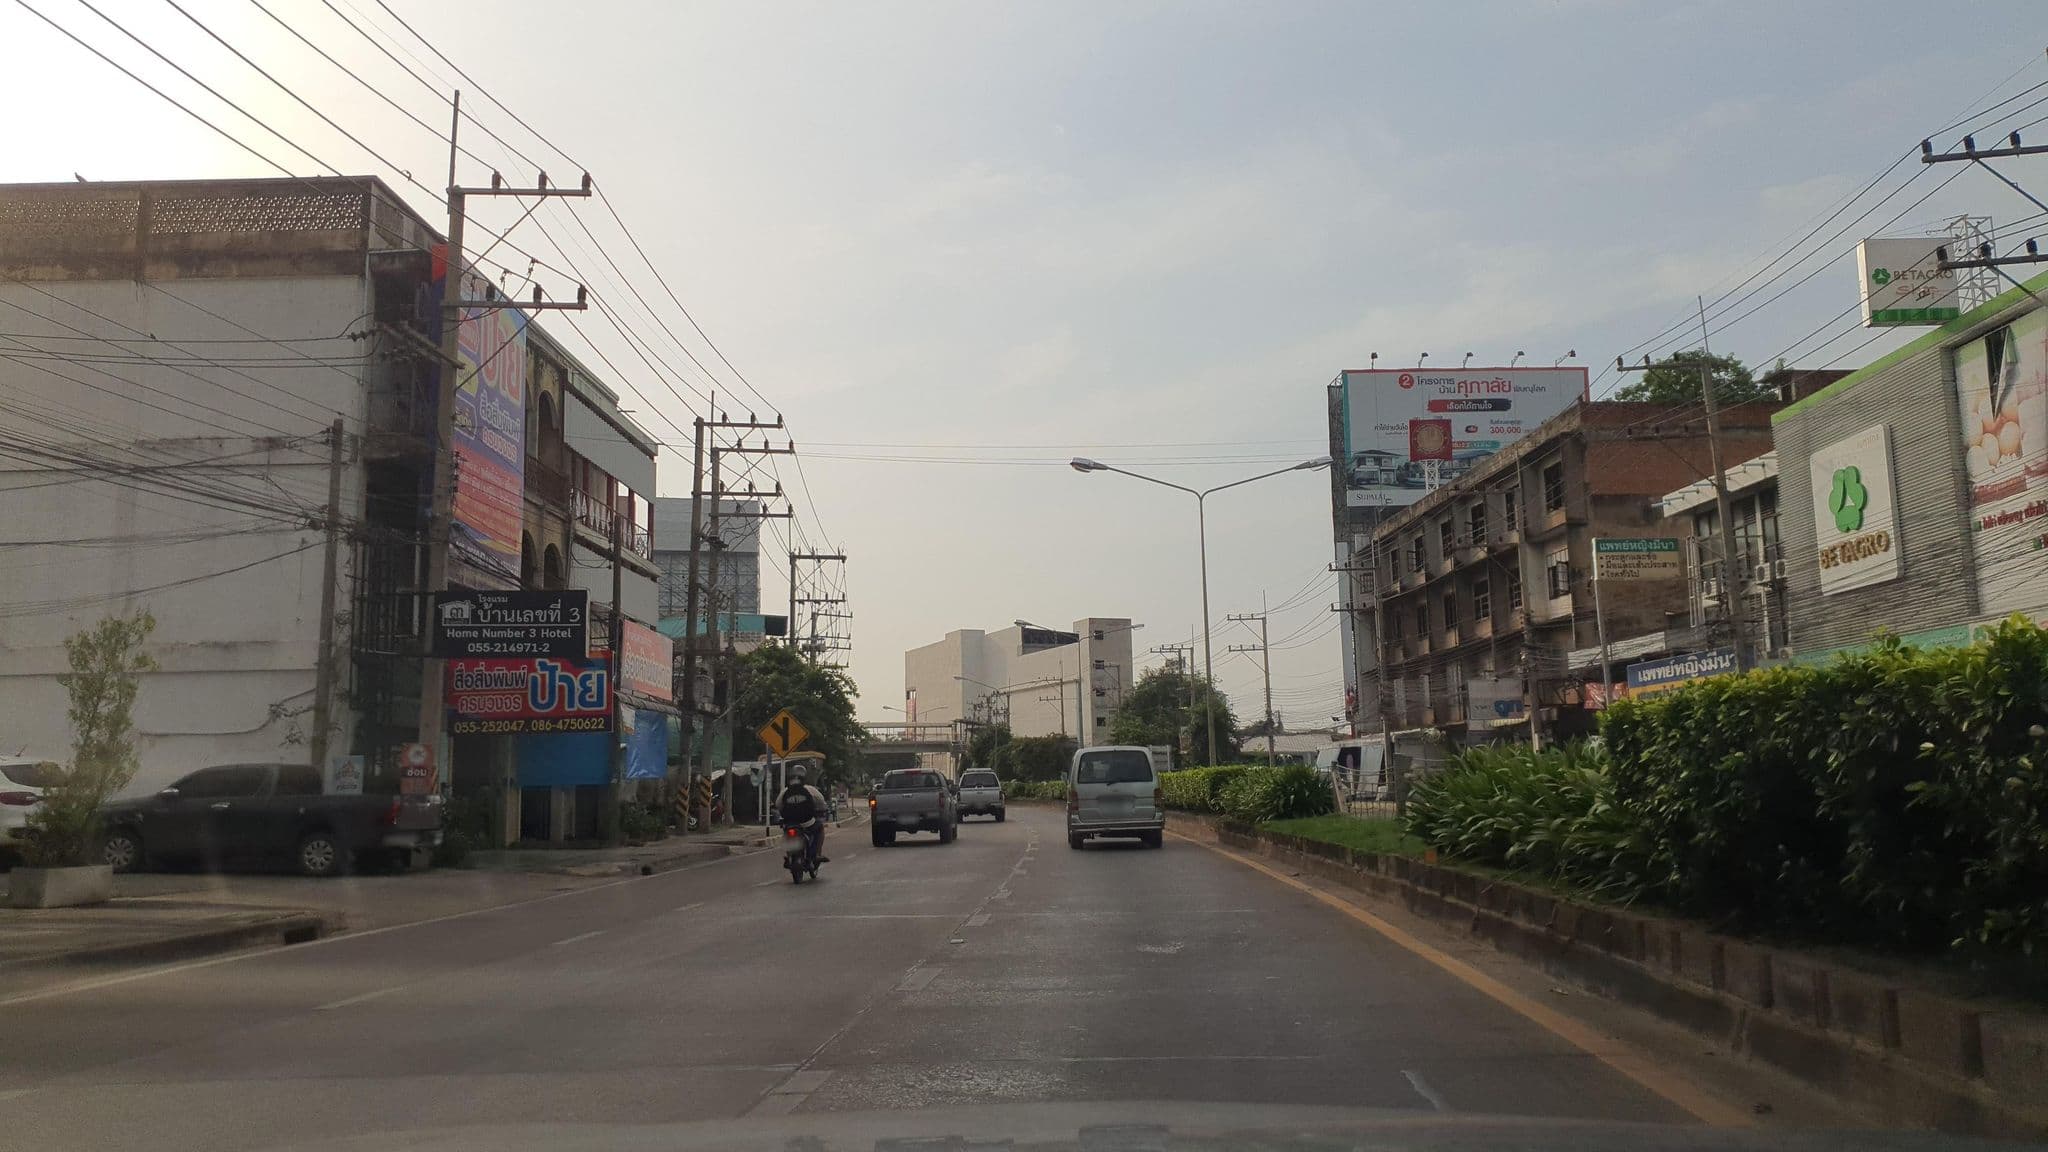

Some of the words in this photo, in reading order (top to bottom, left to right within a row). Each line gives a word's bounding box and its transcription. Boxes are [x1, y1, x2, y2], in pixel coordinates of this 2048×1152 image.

[1893, 269, 1954, 281] BETAGRO
[1417, 375, 1456, 386] โครงการ
[1457, 376, 1512, 398] ศุภาลัย
[1439, 384, 1457, 395] บ้าน
[1489, 426, 1522, 435] 300,000
[1820, 530, 1891, 570] BETAGRO
[477, 594, 508, 604] โรงแรม
[477, 599, 562, 624] บ้านเลขที่
[569, 607, 581, 623] 3
[446, 628, 479, 638] Home
[482, 628, 525, 638] Number
[529, 628, 537, 638] 3
[541, 628, 572, 638] Hotel
[467, 642, 551, 653] 055-214971-2
[454, 661, 529, 690] สื่อสิ่งพิมพ์
[528, 658, 608, 713] ป้าย
[457, 694, 523, 714] ครบวงจร
[531, 717, 606, 732] 086-4750622
